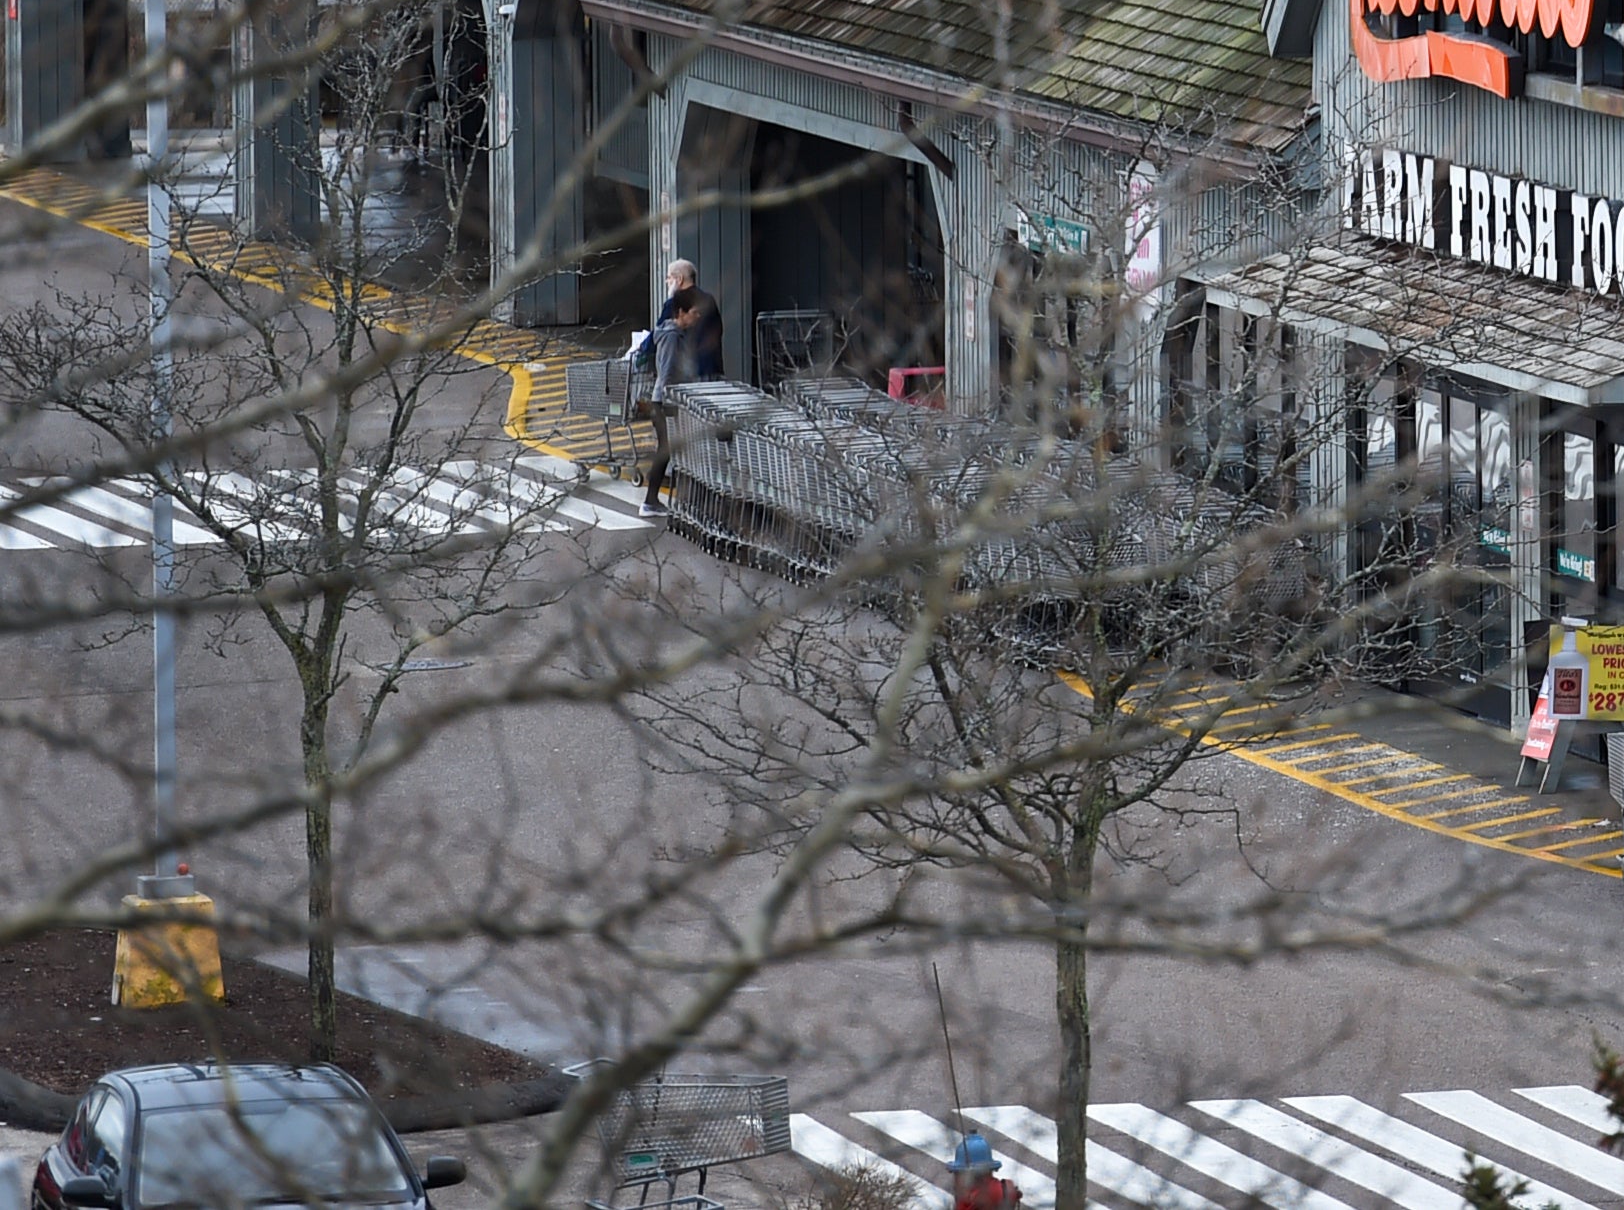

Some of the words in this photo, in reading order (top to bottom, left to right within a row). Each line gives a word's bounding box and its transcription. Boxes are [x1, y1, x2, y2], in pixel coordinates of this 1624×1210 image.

[1343, 140, 1435, 249] FARM
[1450, 164, 1558, 282] FRESH
[1607, 671, 1617, 679] IN
